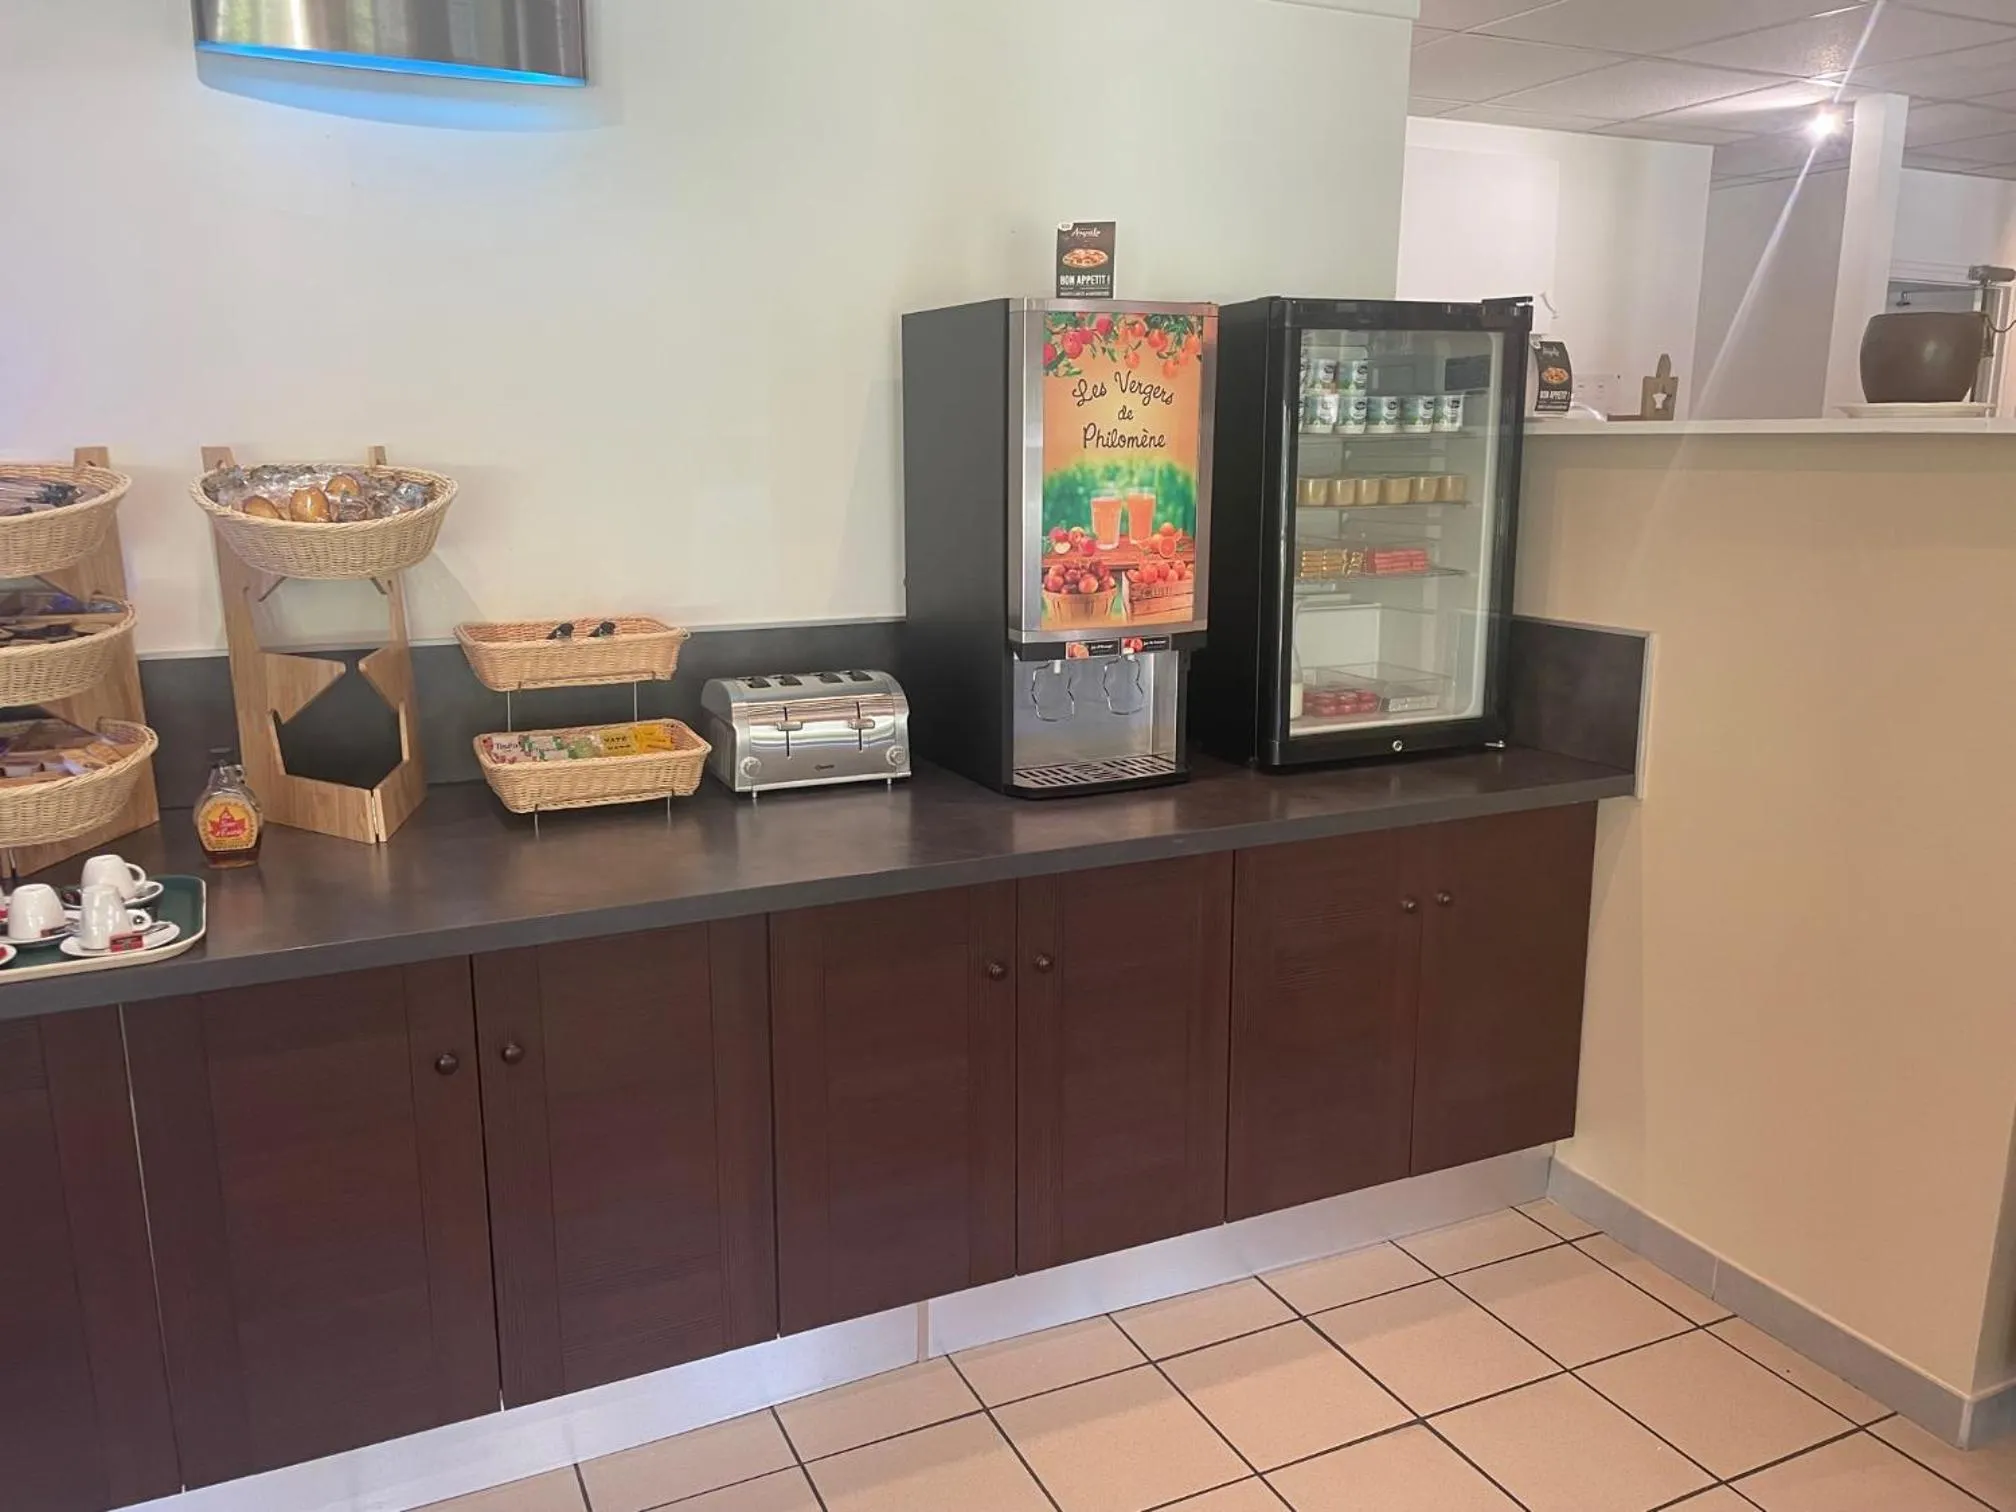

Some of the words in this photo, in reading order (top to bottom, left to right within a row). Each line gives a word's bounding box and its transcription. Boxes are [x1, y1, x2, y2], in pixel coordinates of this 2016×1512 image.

[1060, 274, 1075, 286] BON
[1077, 274, 1106, 285] APPETIT
[1072, 379, 1107, 407] Les
[1114, 370, 1174, 406] Vergers
[1118, 405, 1134, 420] de
[1083, 422, 1166, 449] Philomène
